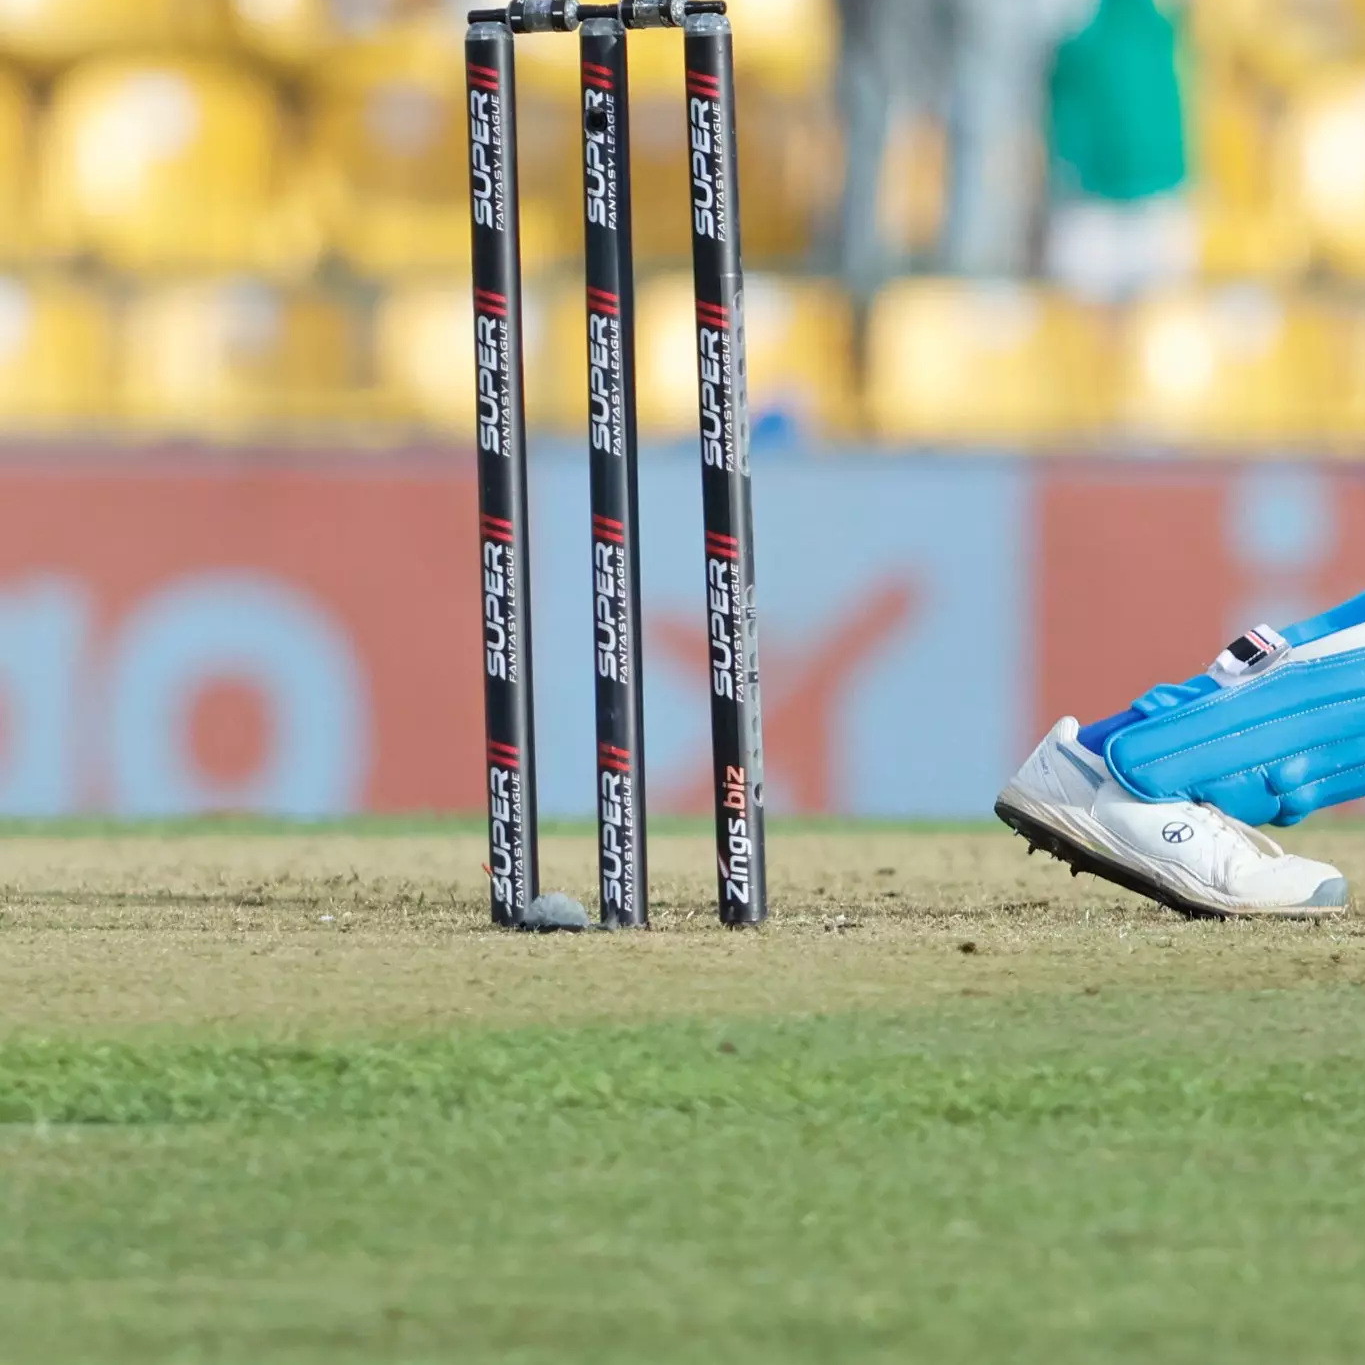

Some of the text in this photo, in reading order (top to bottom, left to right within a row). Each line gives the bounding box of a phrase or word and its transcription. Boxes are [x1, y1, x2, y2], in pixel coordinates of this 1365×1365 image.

[490, 94, 505, 232] FANTASY LEAGUE
[605, 93, 618, 231] FANTASY LEAGUE
[711, 101, 726, 243] FANTASY LEAGUE
[498, 320, 511, 458] FANTASY LEAGUE
[609, 319, 622, 457] FANTASY LEAGUE
[720, 332, 735, 473] FANTASY LEAGUE
[505, 545, 518, 684] FANTASY LEAGUE
[614, 546, 629, 685] FANTASY LEAGUE
[730, 563, 745, 703] FANTASY LEAGUE
[510, 772, 525, 909] FANTASY LEAGUE
[622, 775, 634, 913] FANTASY LEAGUE
